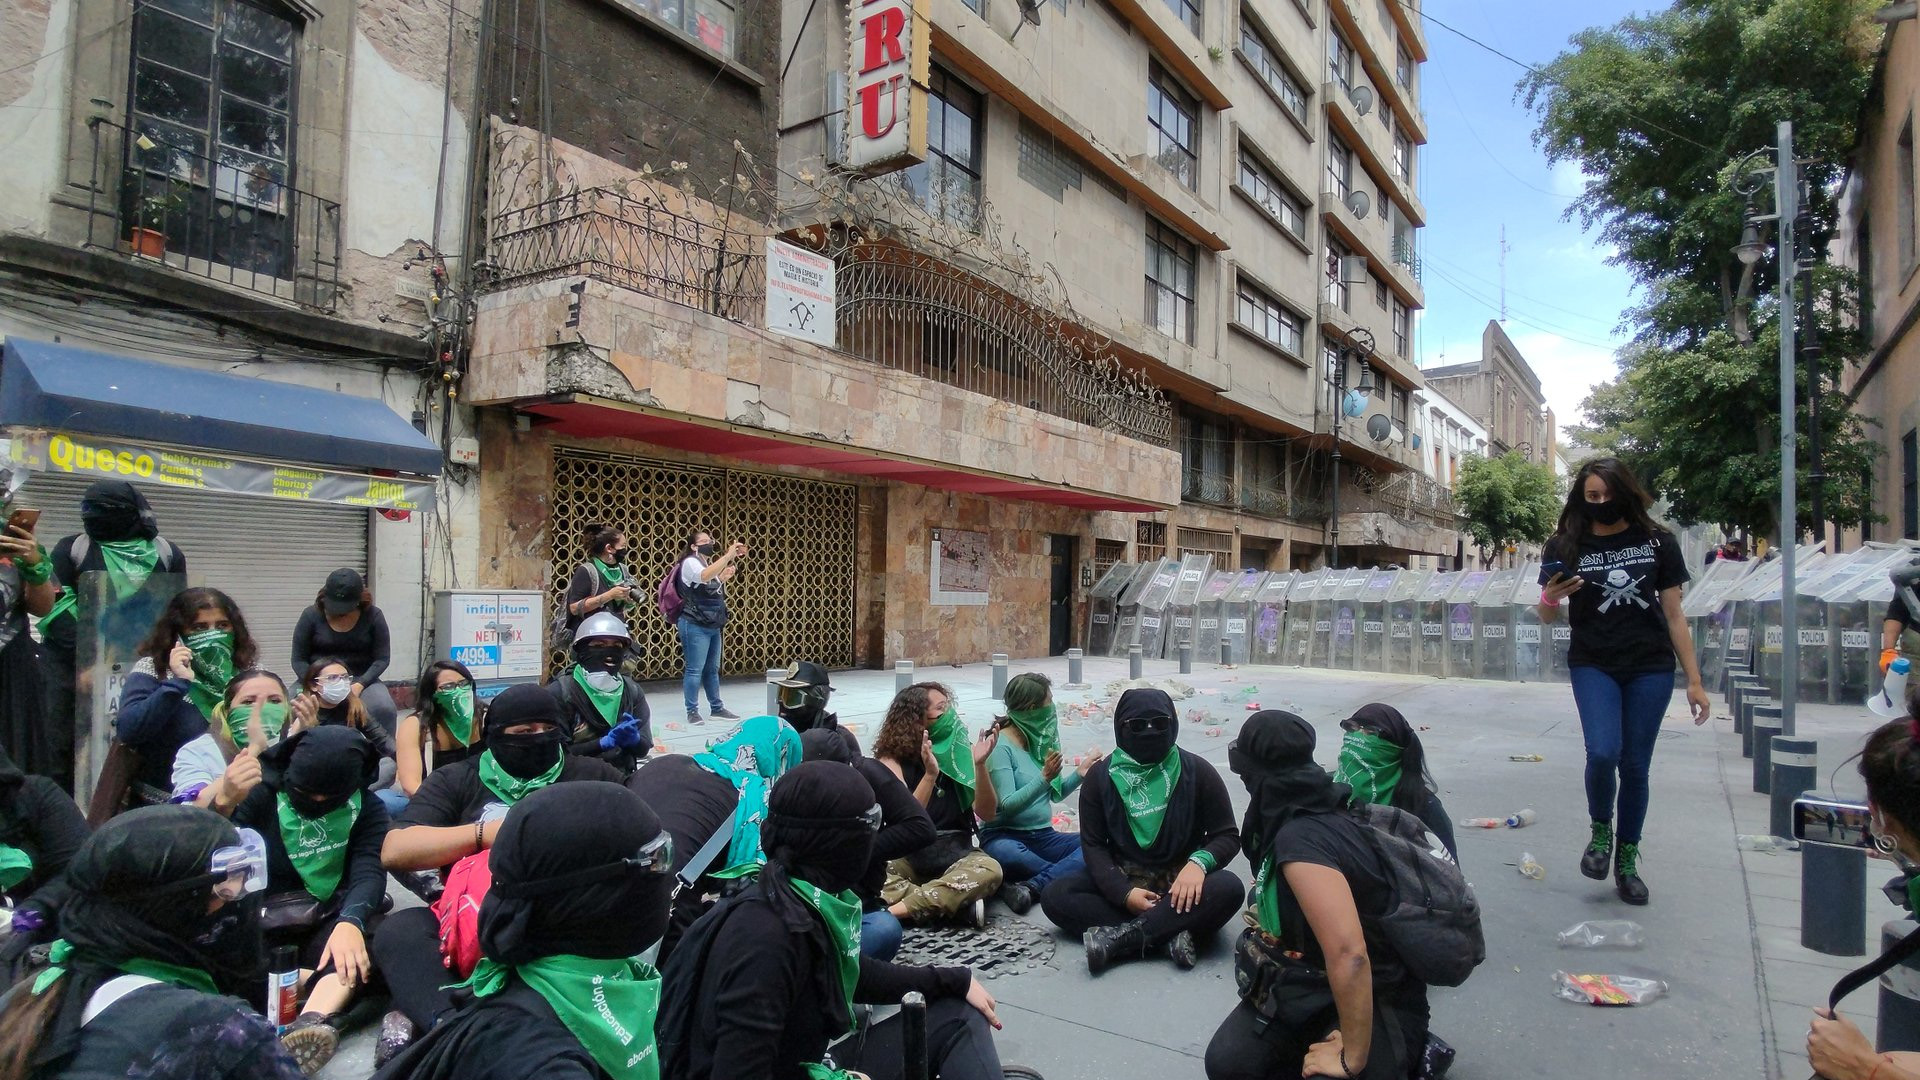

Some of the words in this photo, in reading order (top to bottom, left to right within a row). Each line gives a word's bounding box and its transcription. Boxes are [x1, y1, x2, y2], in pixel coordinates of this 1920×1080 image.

[49, 434, 154, 478] Queso
[466, 604, 530, 614] infinitum
[1364, 623, 1382, 631] POLICIA
[1484, 626, 1504, 636] POLICIA
[475, 630, 523, 643] NETIX
[1801, 632, 1826, 643] POLICIA
[1843, 634, 1868, 646] POLICIA
[592, 986, 634, 1047] Educación
